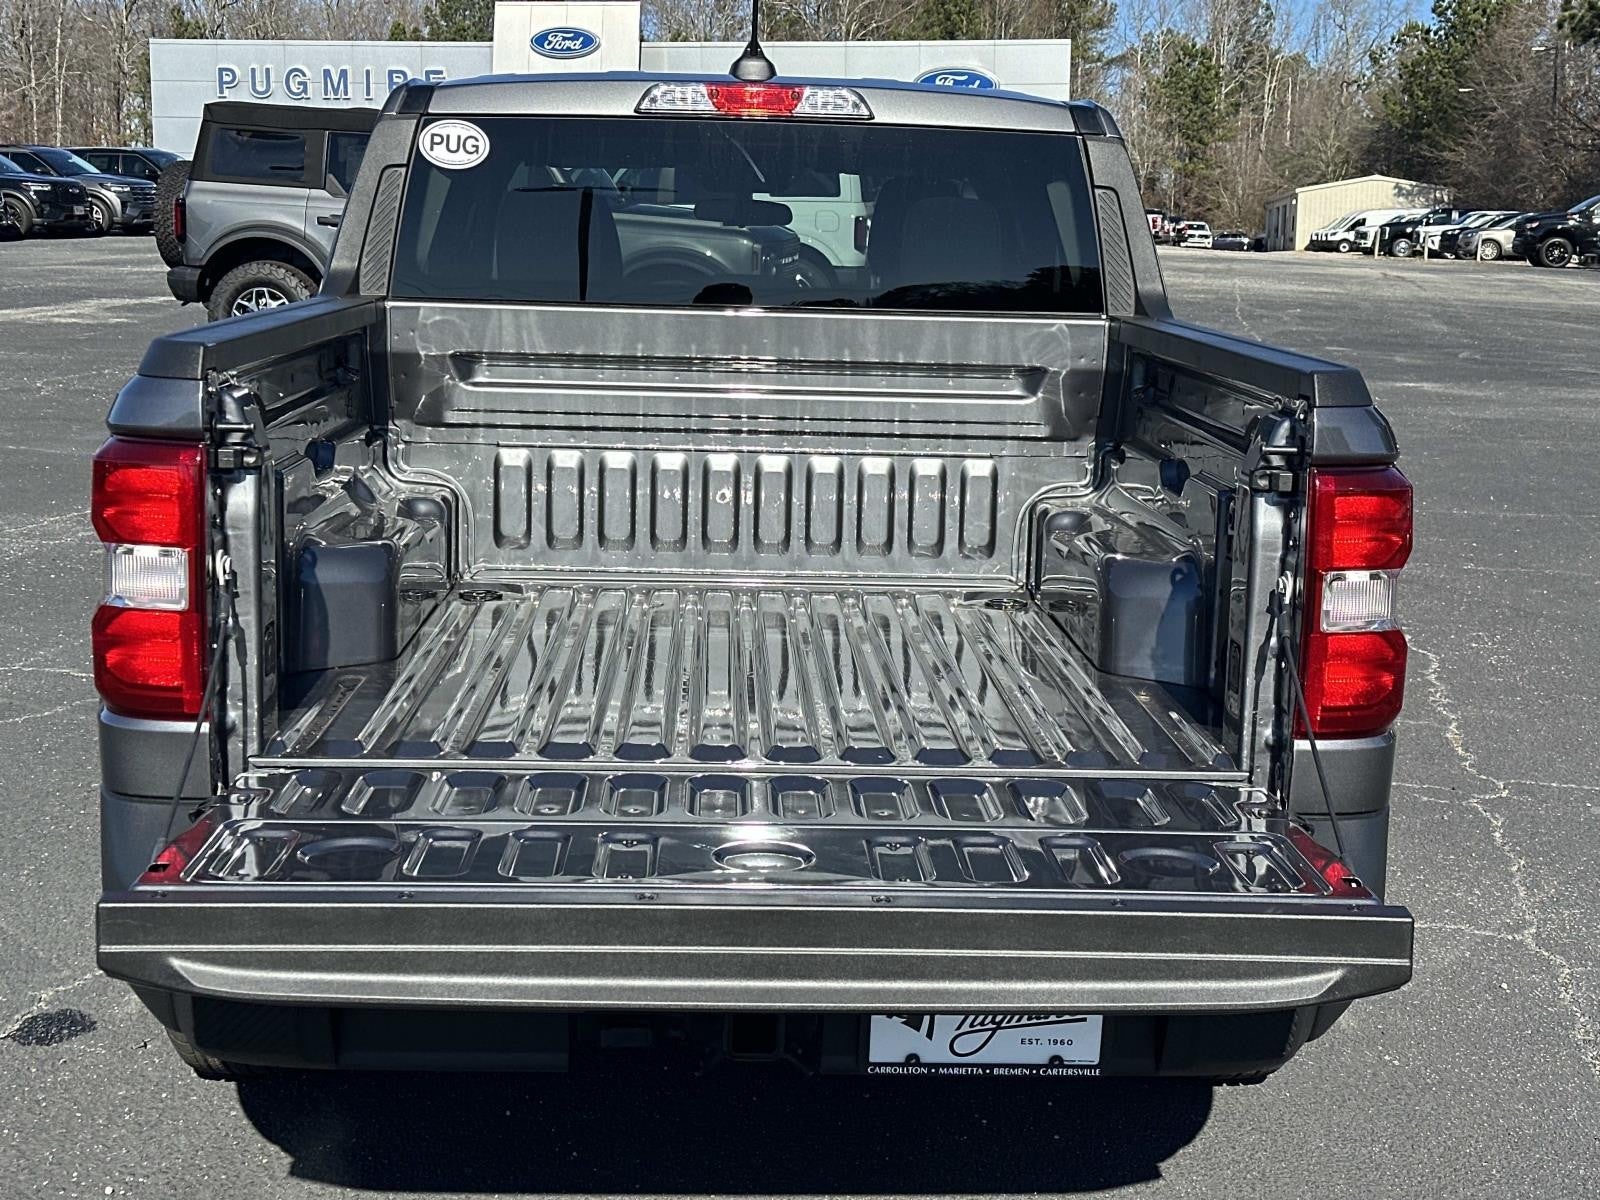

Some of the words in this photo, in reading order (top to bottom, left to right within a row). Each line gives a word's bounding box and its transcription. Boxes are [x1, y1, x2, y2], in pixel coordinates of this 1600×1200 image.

[543, 32, 584, 50] Ford
[429, 132, 480, 155] PUG
[1020, 1038, 1043, 1046] EST.
[1047, 1038, 1074, 1046] 1960
[867, 1066, 928, 1075] CARROLLTON
[938, 1067, 984, 1075] MARIETTA
[993, 1067, 1030, 1076] BREMEN
[1039, 1067, 1101, 1076] CARTERSVILLE
